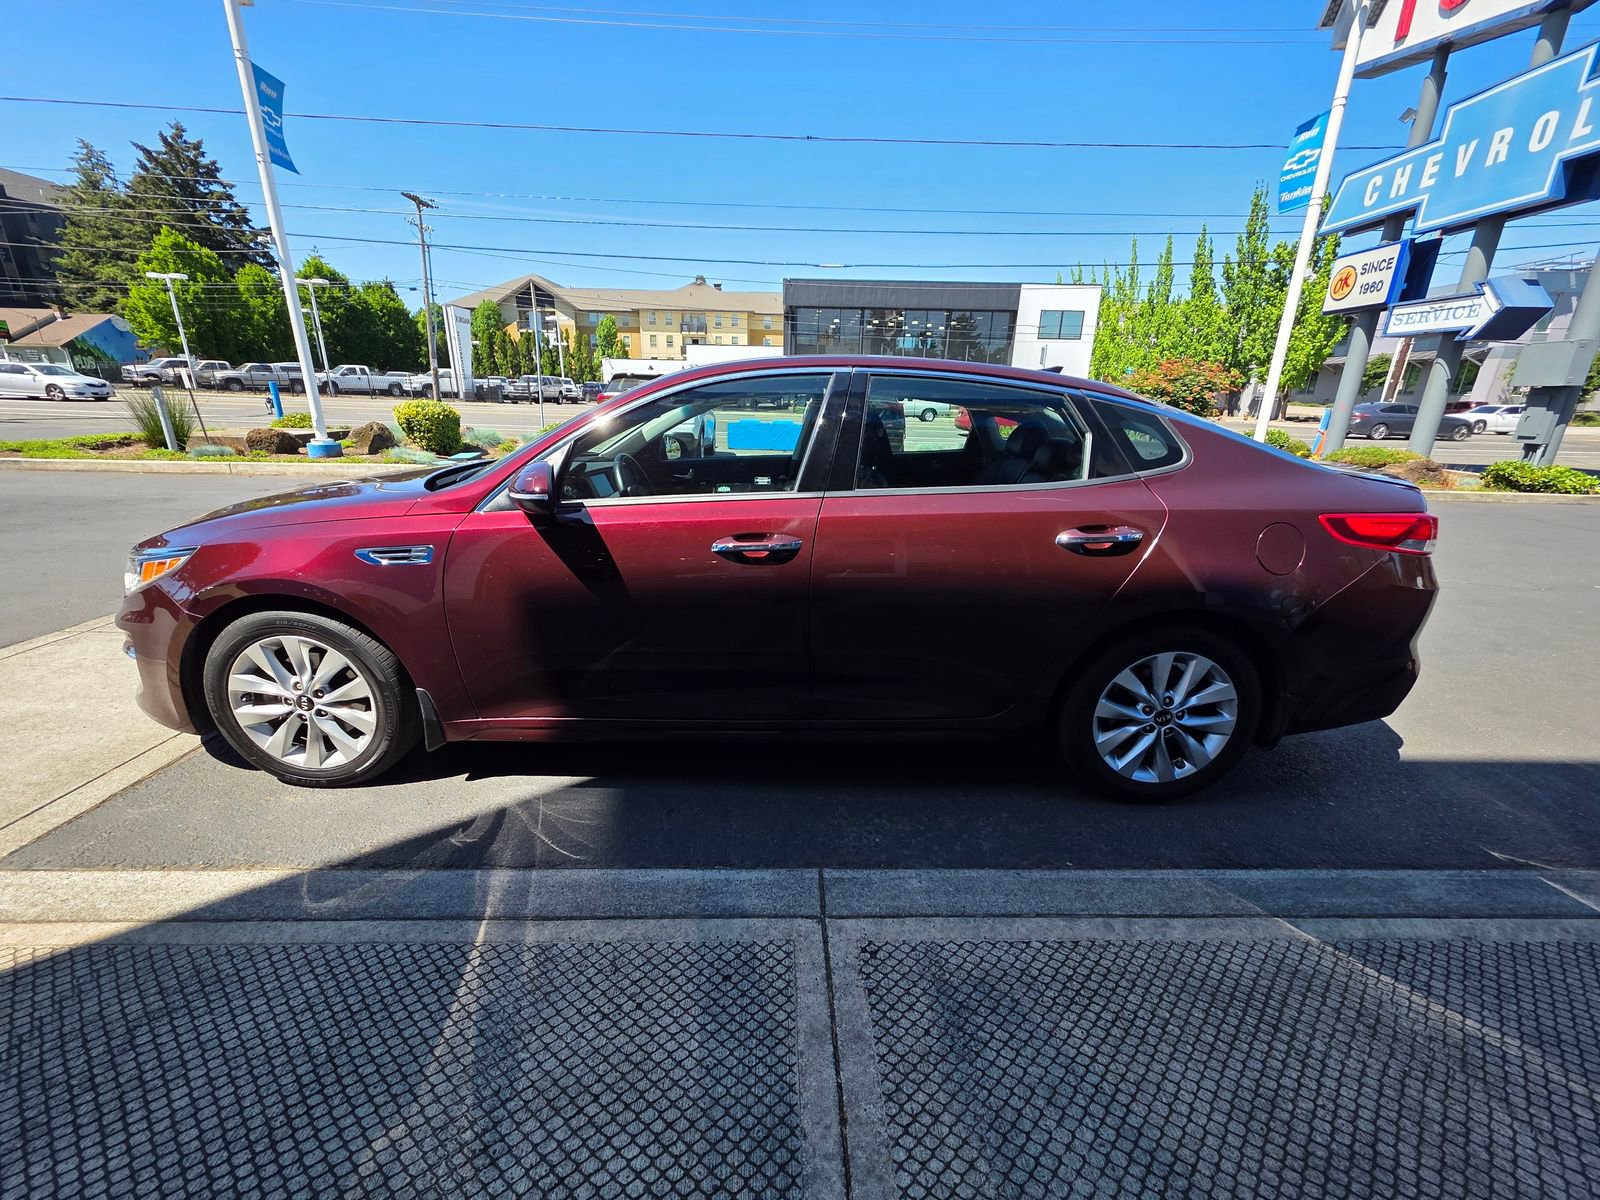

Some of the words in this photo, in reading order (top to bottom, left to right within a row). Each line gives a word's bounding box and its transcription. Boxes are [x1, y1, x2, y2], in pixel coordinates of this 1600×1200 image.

[1363, 96, 1594, 207] CHEVROL
[1360, 256, 1395, 276] SINCE
[1333, 271, 1352, 295] OK
[1358, 279, 1385, 296] 1960
[1392, 303, 1482, 327] SERVICE
[300, 696, 308, 710] KIA
[1156, 713, 1172, 722] KIA
